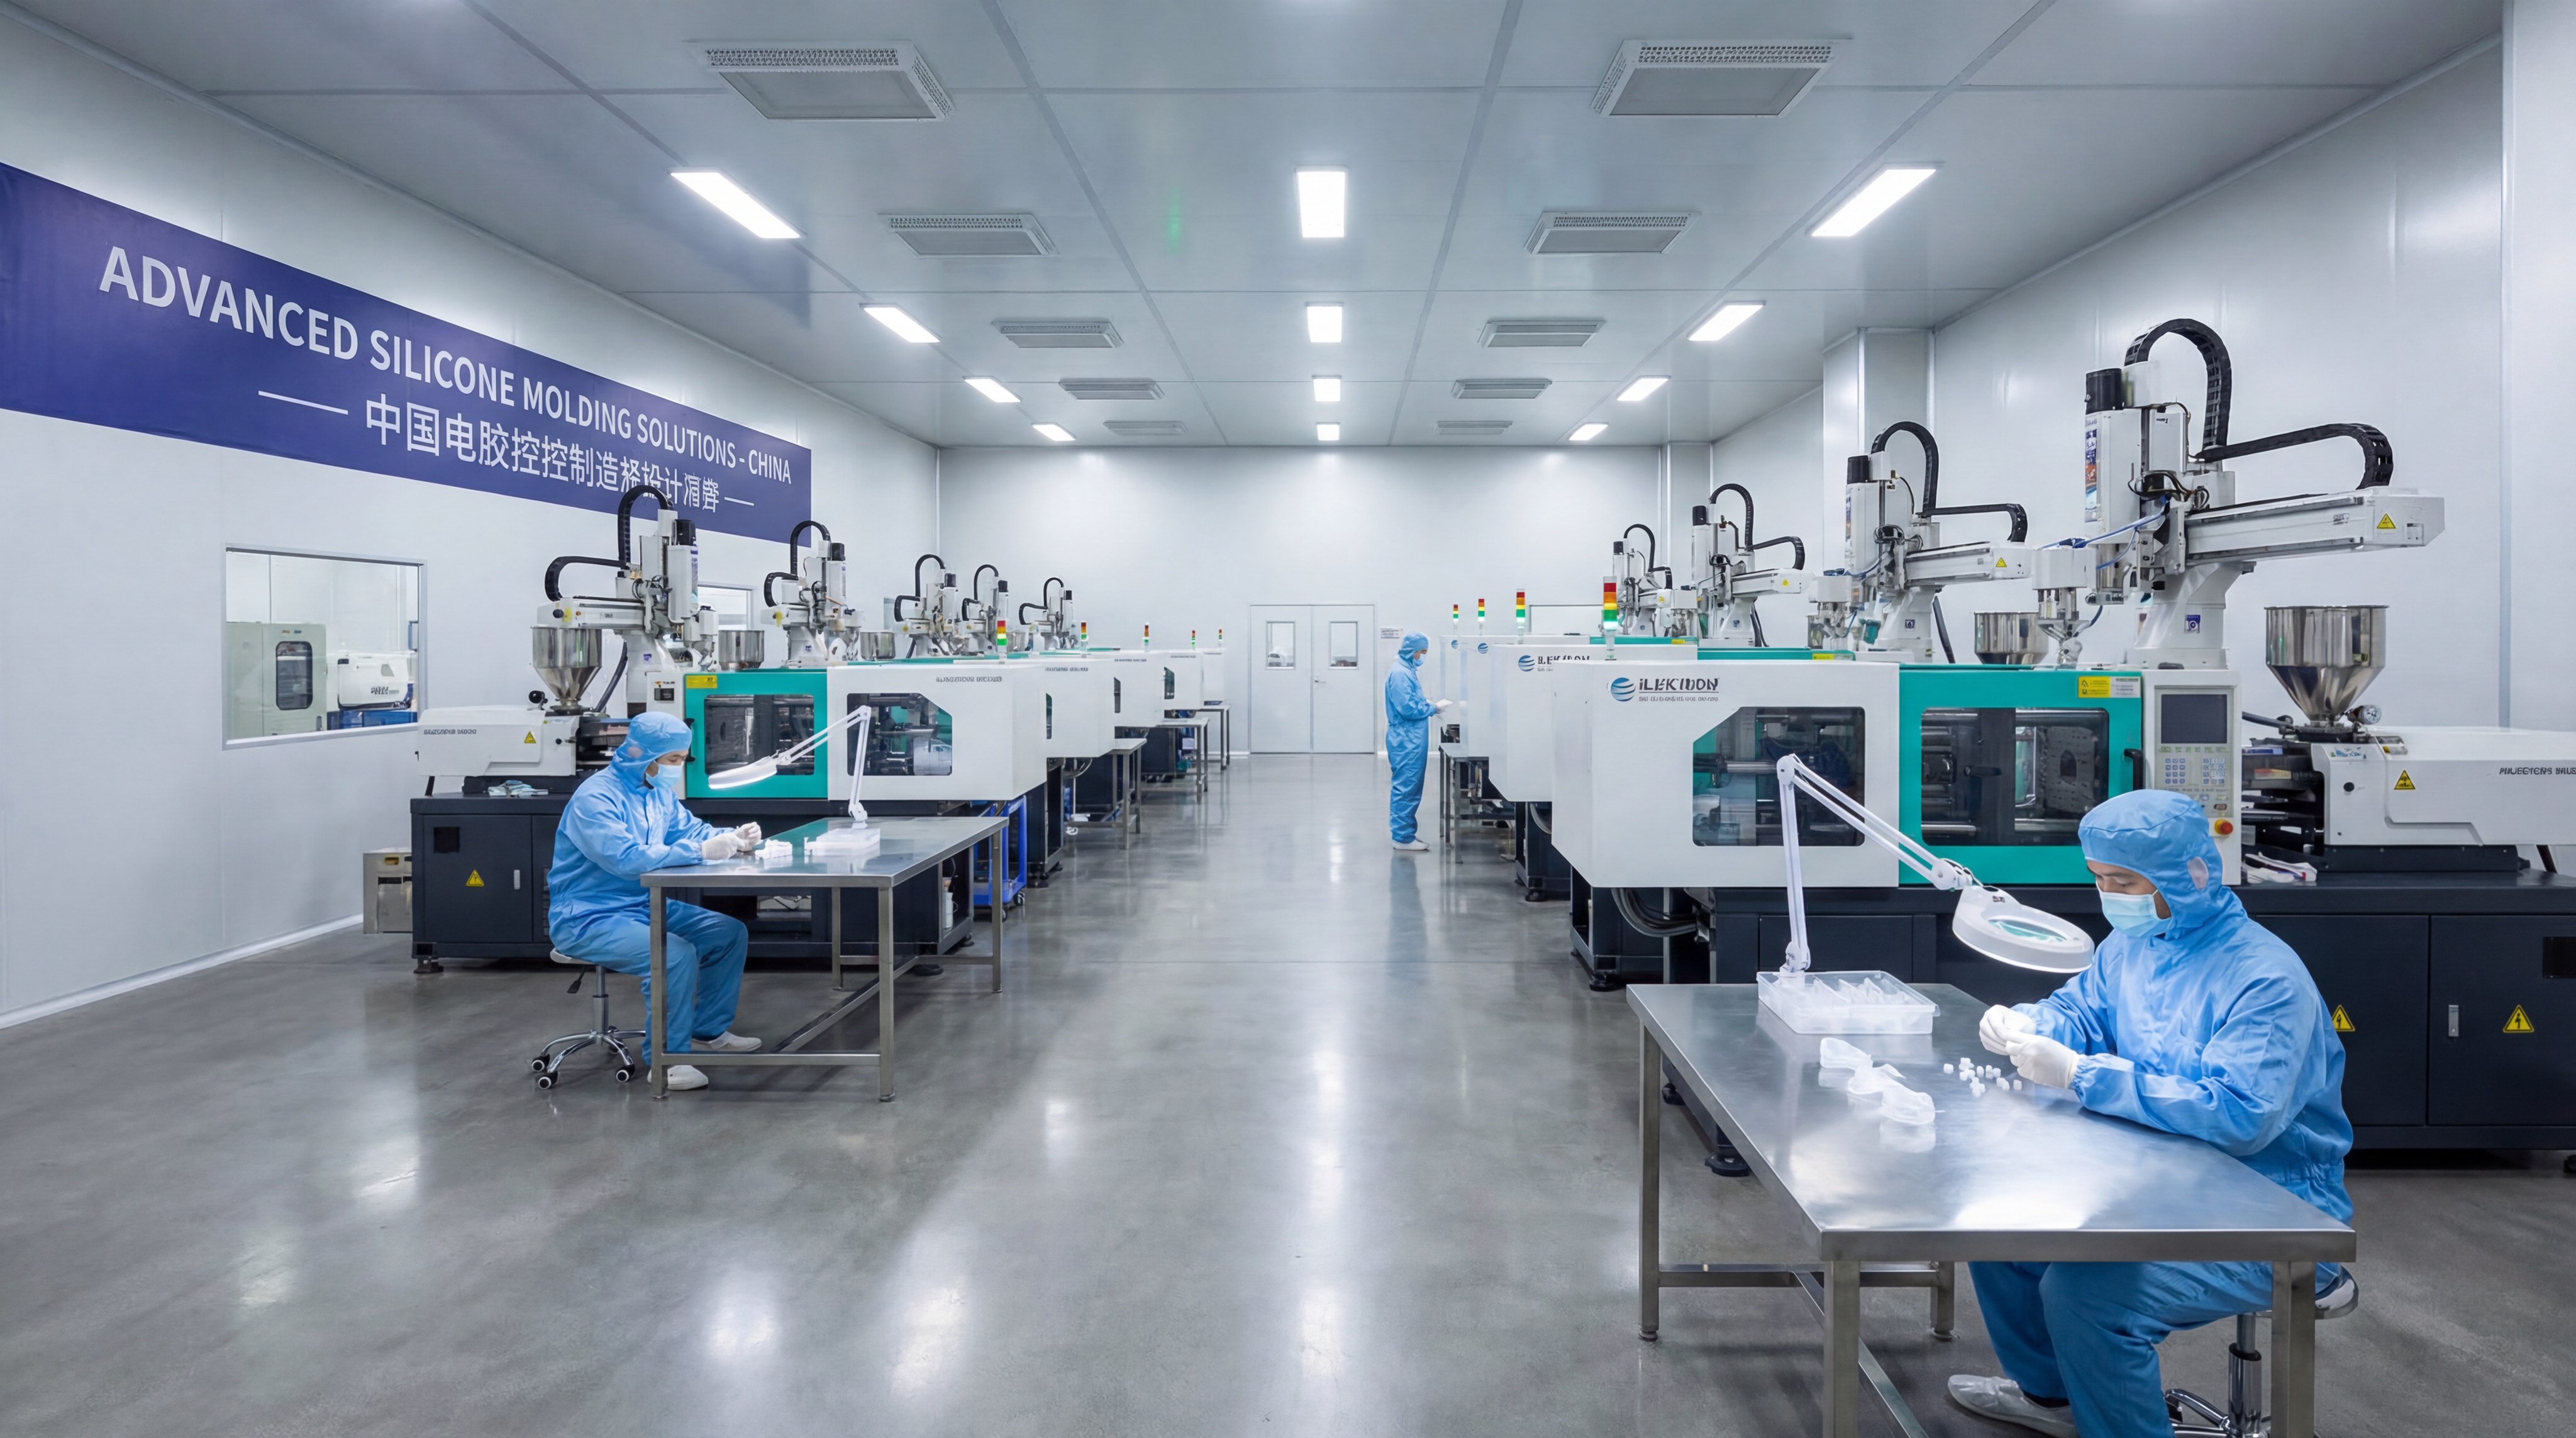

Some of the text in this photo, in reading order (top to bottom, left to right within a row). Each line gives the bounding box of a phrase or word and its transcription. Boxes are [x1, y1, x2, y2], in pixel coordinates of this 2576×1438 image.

[99, 246, 358, 360] ADVANCED
[370, 330, 514, 407] SILICONE
[524, 377, 631, 439] MOLDING
[637, 413, 736, 468] SOLUTIONS
[748, 449, 791, 484] CHINA
